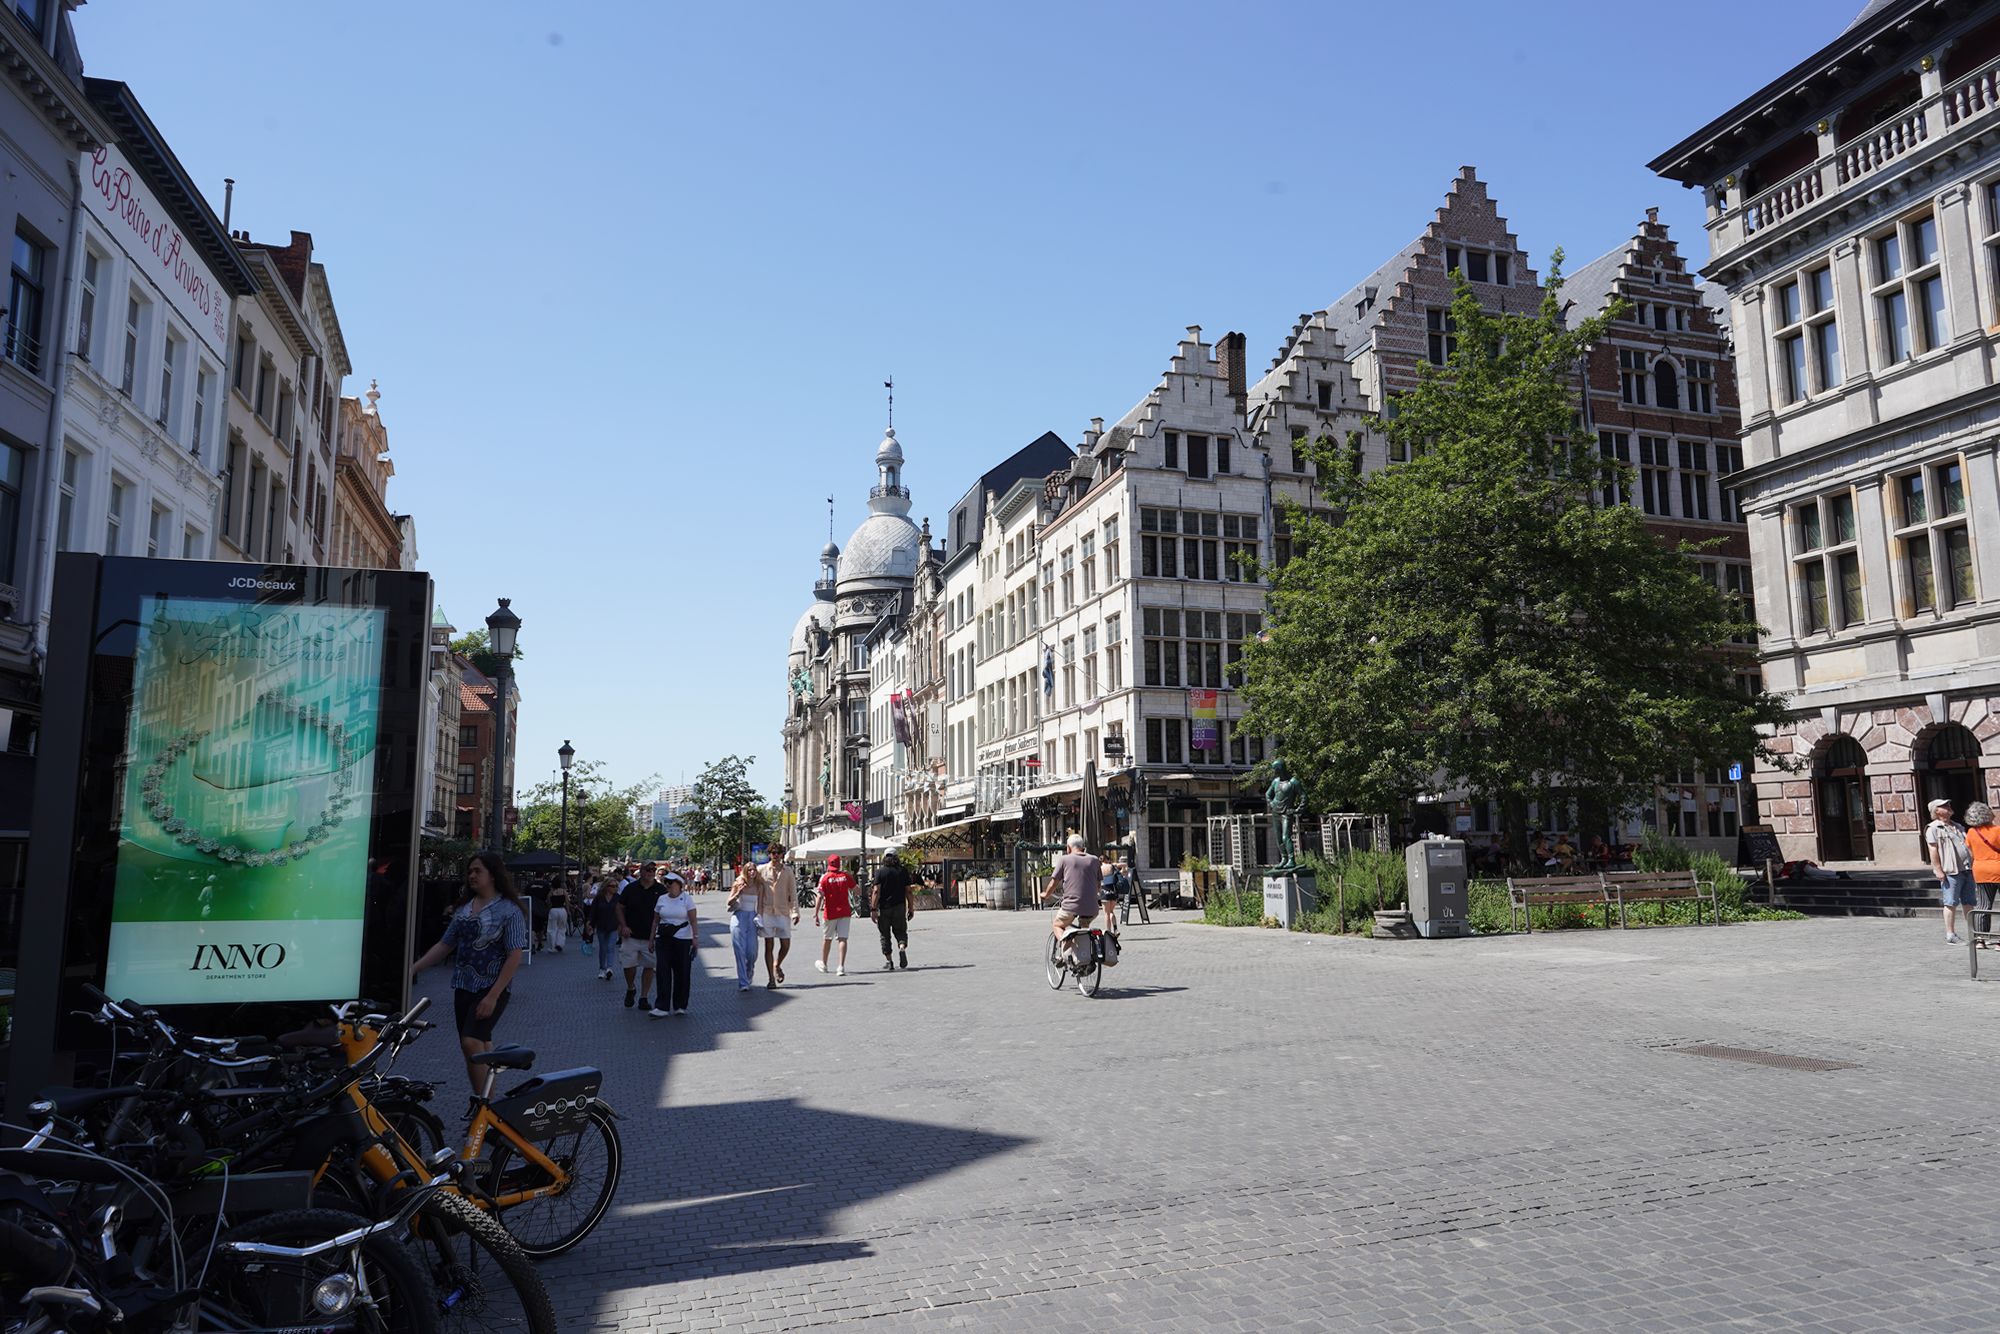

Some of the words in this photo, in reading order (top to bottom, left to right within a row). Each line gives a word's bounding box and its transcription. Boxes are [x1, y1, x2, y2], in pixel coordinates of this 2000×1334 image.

[91, 147, 110, 201] La
[107, 167, 151, 244] Reine
[227, 577, 297, 592] JCDecaux
[149, 607, 376, 645] SWAROVSKI
[188, 943, 286, 971] INNO
